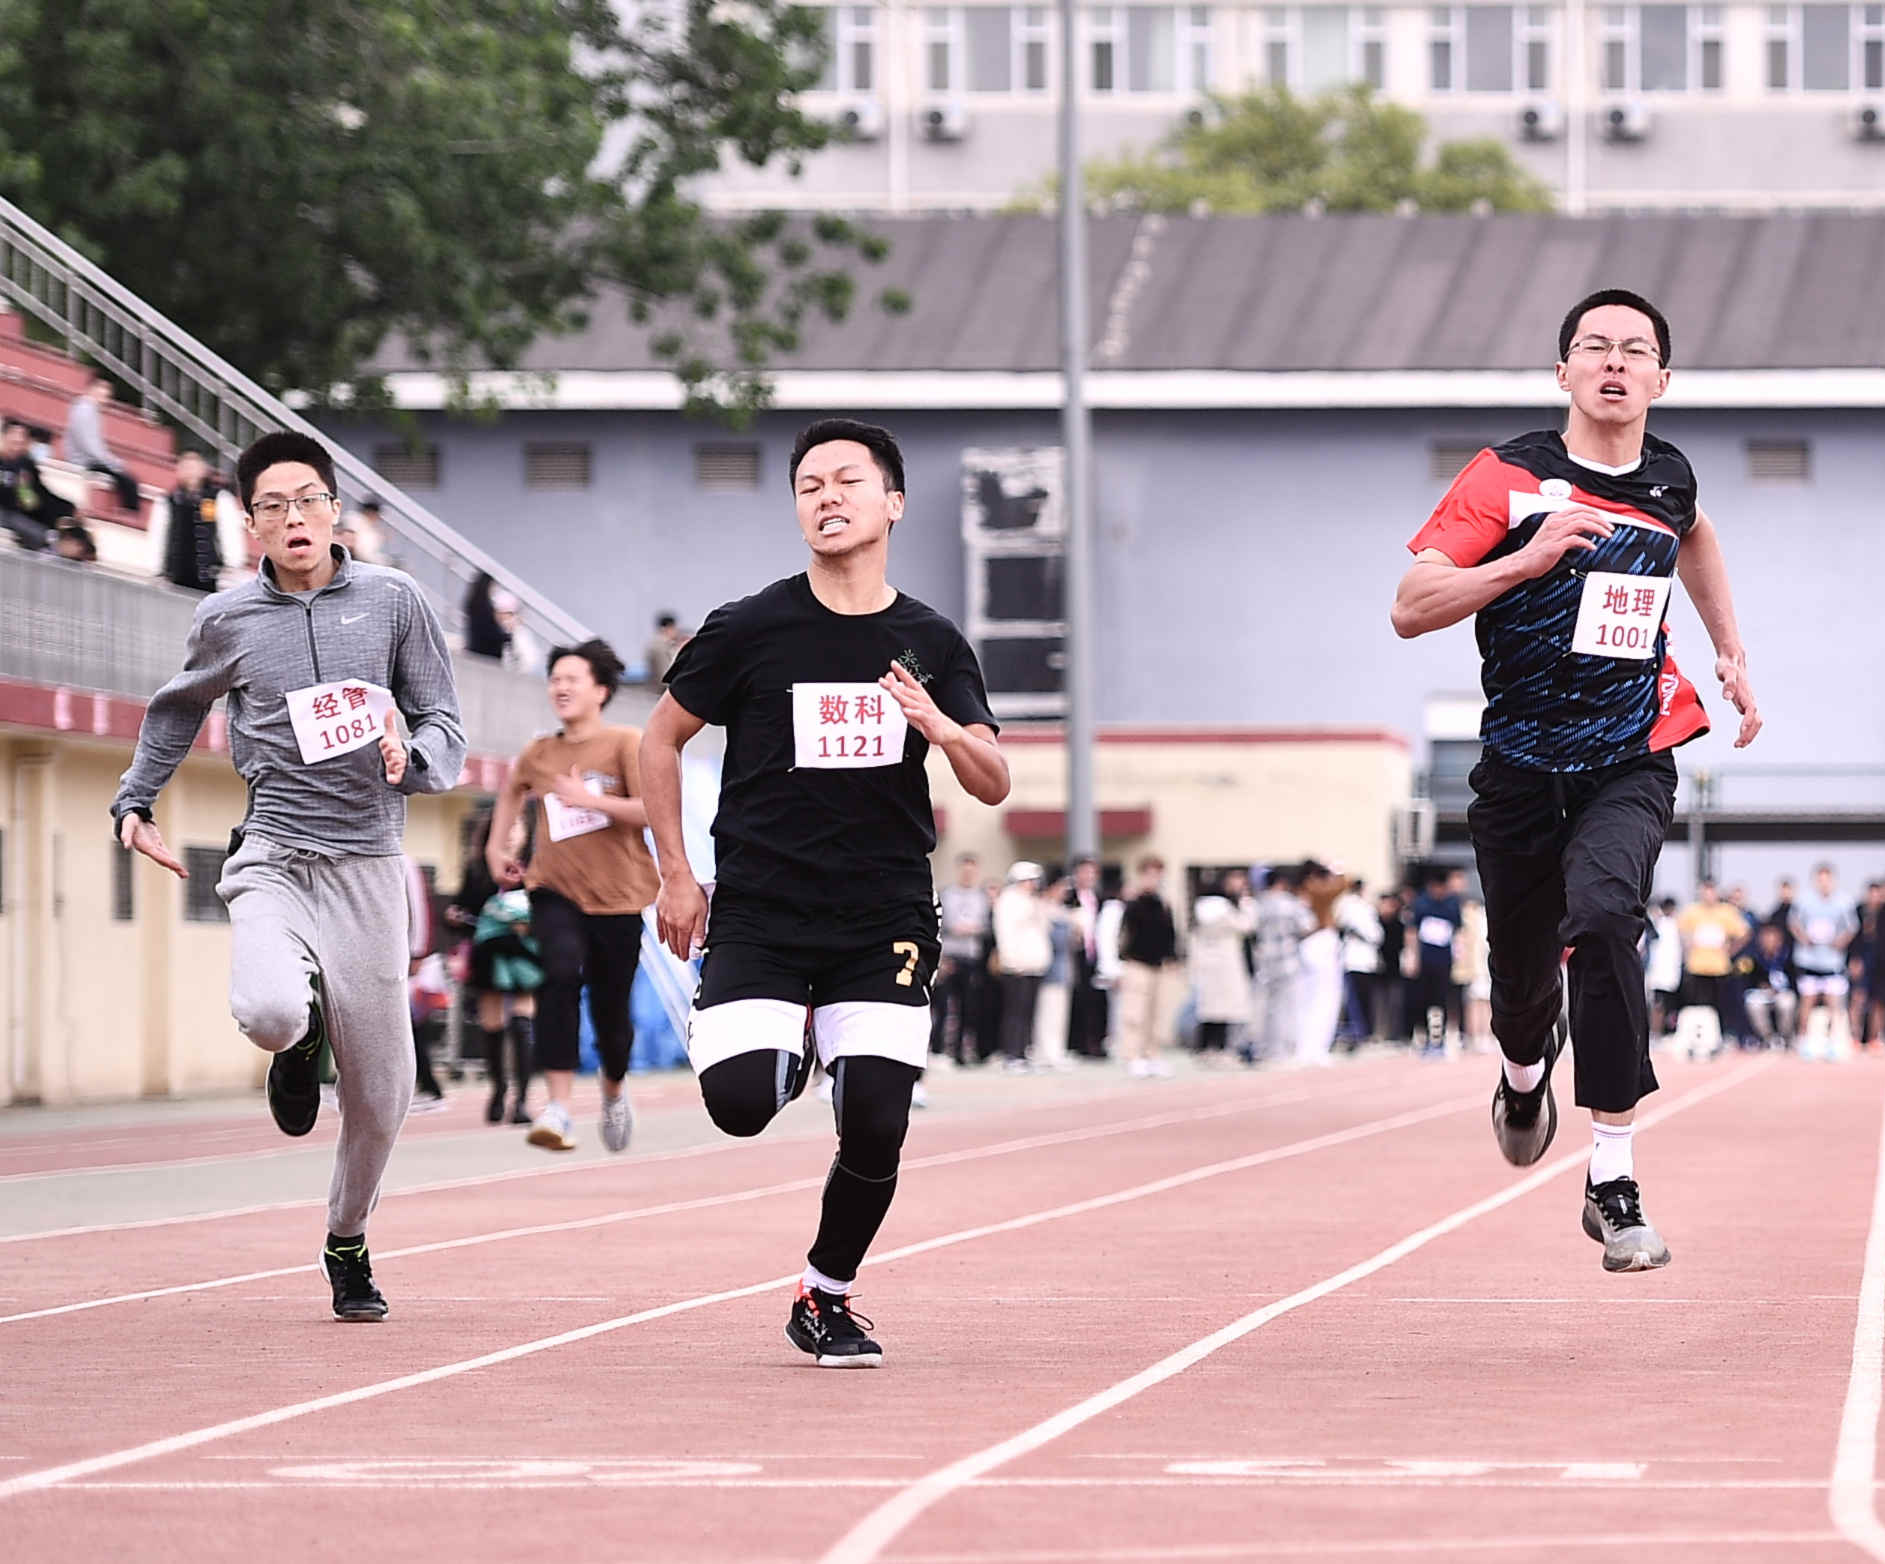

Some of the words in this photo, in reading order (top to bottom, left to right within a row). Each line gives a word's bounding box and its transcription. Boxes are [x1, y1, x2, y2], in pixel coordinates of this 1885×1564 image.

[1602, 584, 1656, 616] 地理
[1595, 623, 1649, 649] 1001
[311, 687, 369, 720] 经管
[818, 694, 885, 725] 数科
[319, 713, 377, 749] 1081
[817, 735, 885, 758] 1121
